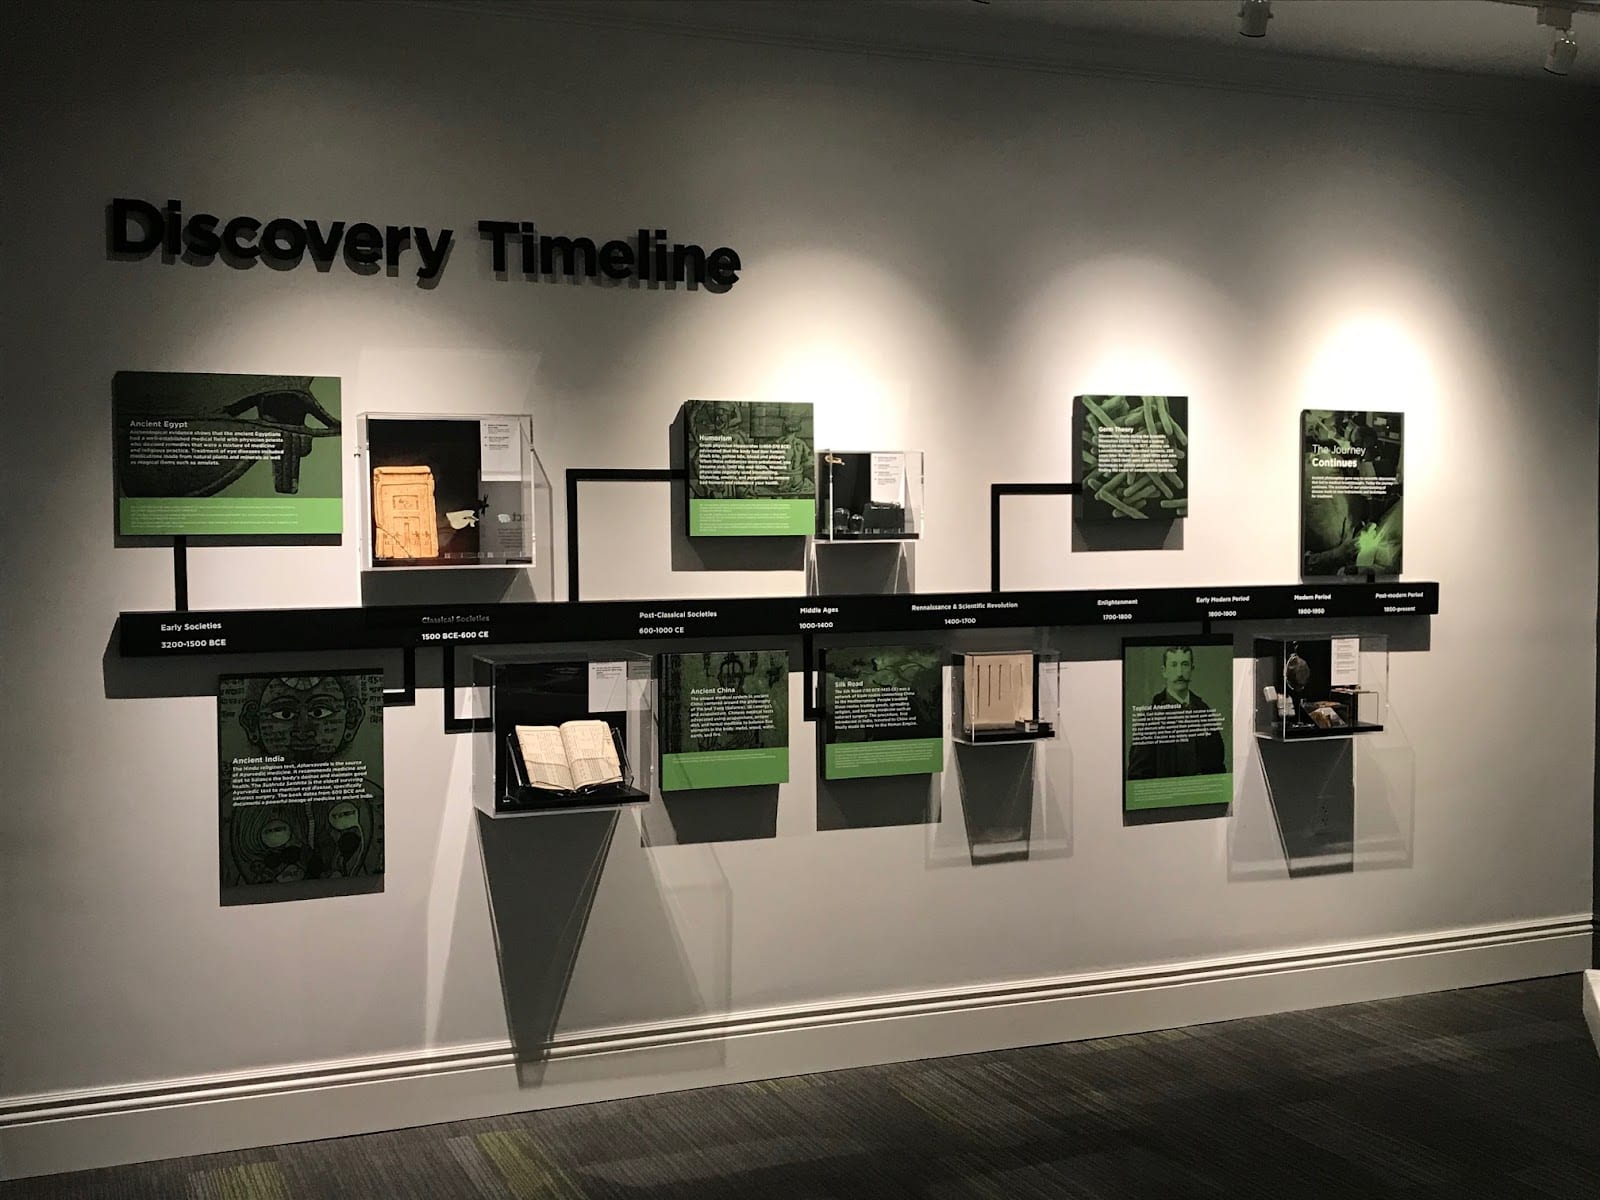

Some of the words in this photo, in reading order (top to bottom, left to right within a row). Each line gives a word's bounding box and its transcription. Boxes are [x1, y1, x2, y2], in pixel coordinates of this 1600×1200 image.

[113, 198, 453, 278] Discovery
[478, 221, 741, 284] Timeline
[1312, 444, 1329, 453] The
[1332, 445, 1366, 456] Journey
[1312, 458, 1357, 467] Continues
[184, 622, 222, 630] Societies
[161, 640, 207, 648] 3200-1500
